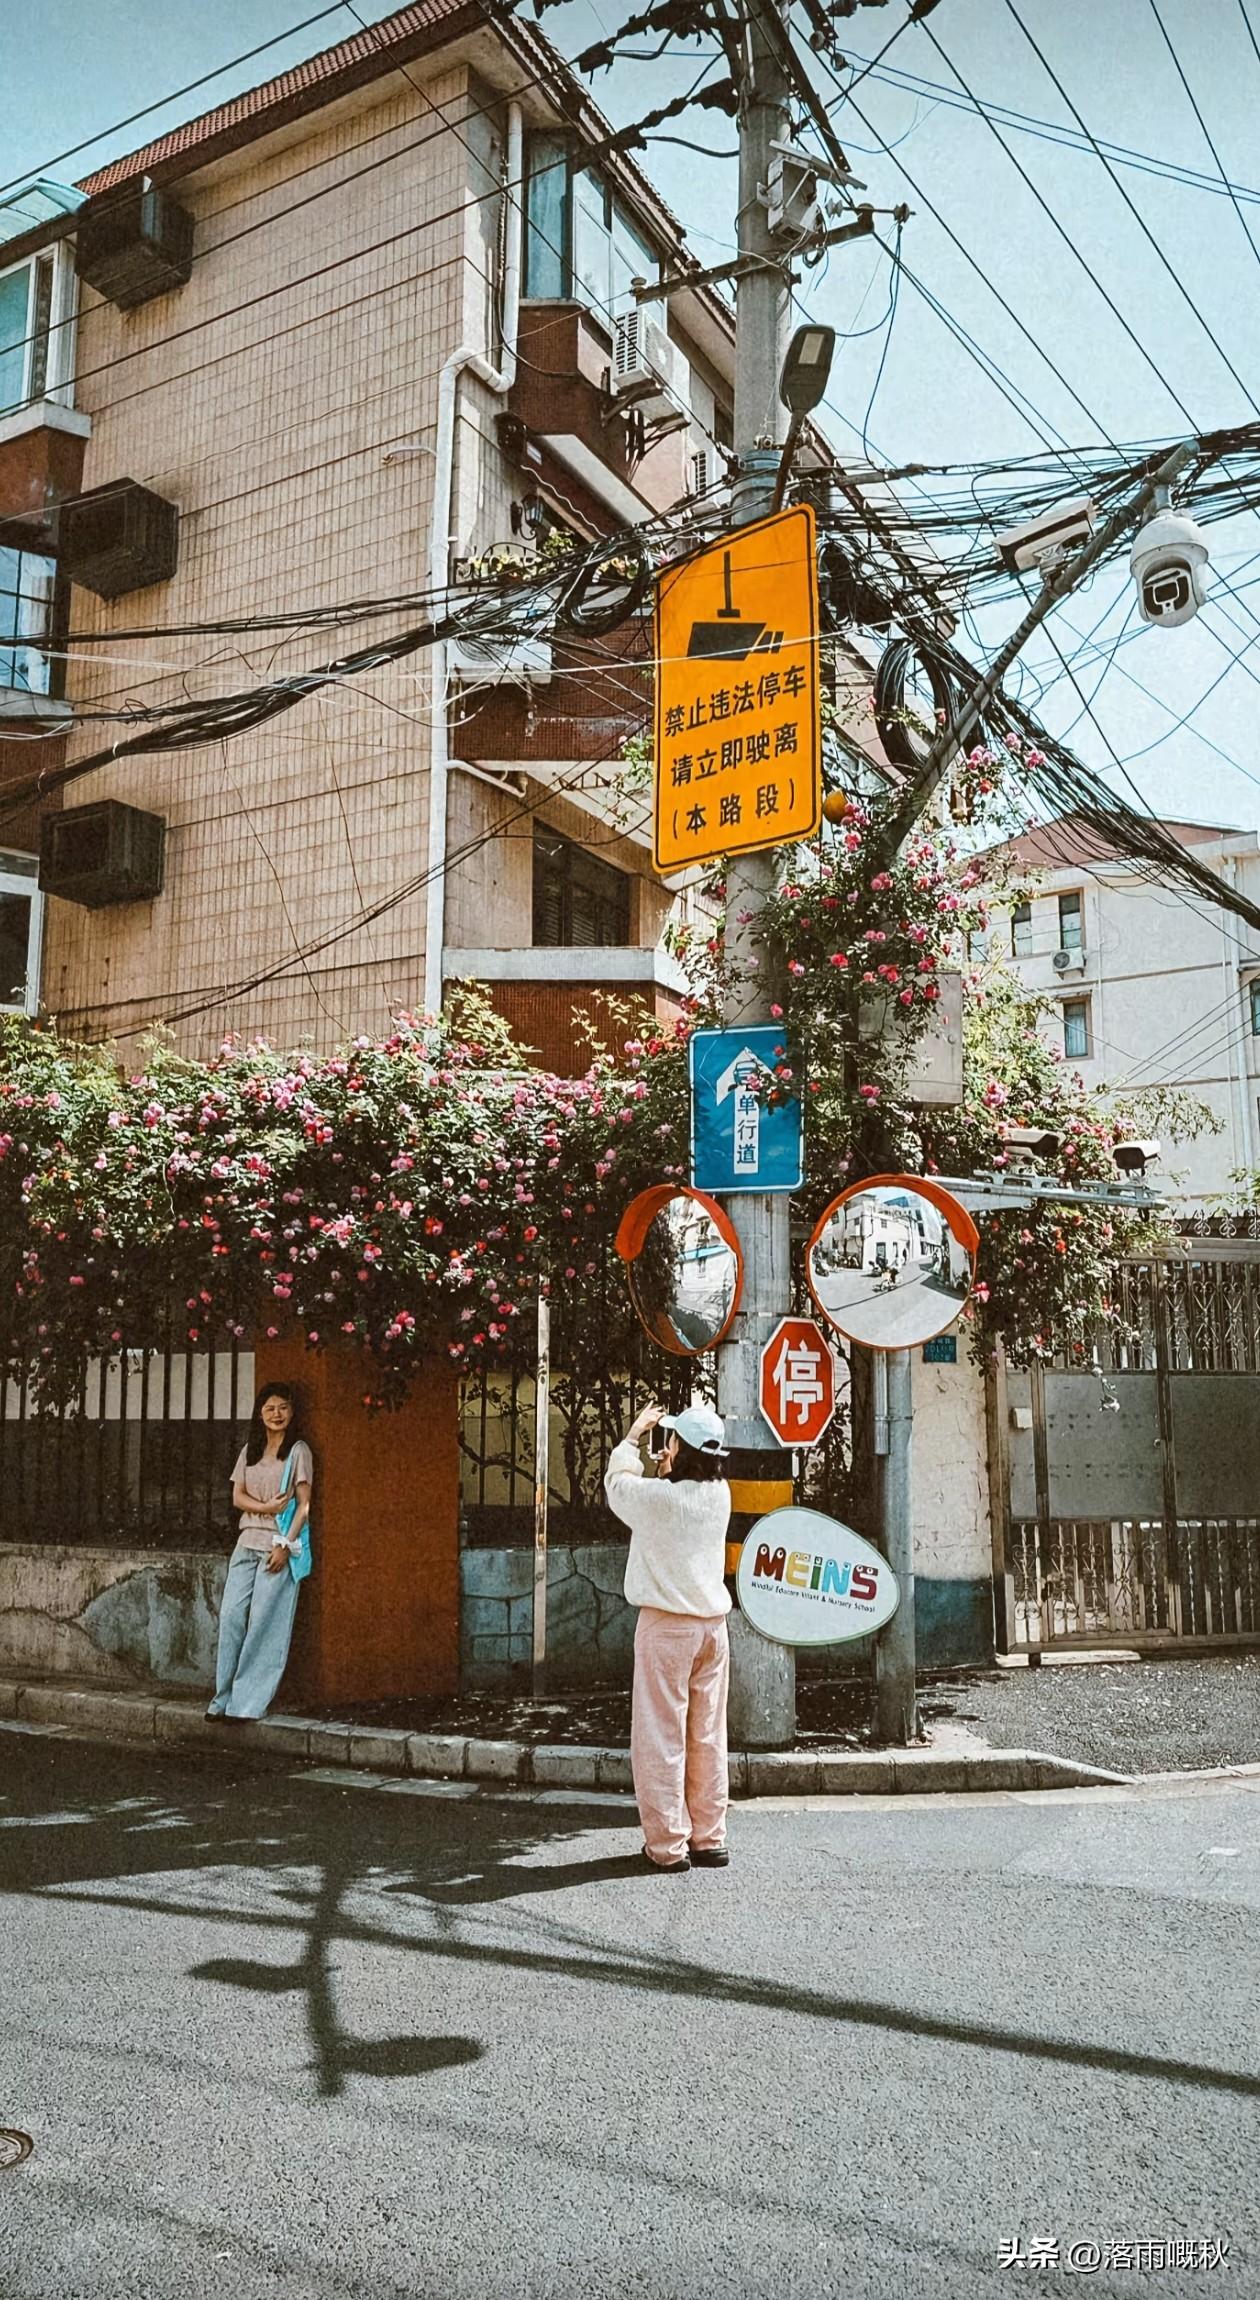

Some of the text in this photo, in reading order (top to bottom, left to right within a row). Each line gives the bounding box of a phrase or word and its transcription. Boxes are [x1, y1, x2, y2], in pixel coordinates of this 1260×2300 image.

[664, 664, 807, 738] 禁止违法停车
[670, 722, 799, 788] 请立即驶离
[736, 1094, 758, 1165] 单行道
[772, 1337, 824, 1425] 停
[854, 1602, 876, 1613] School
